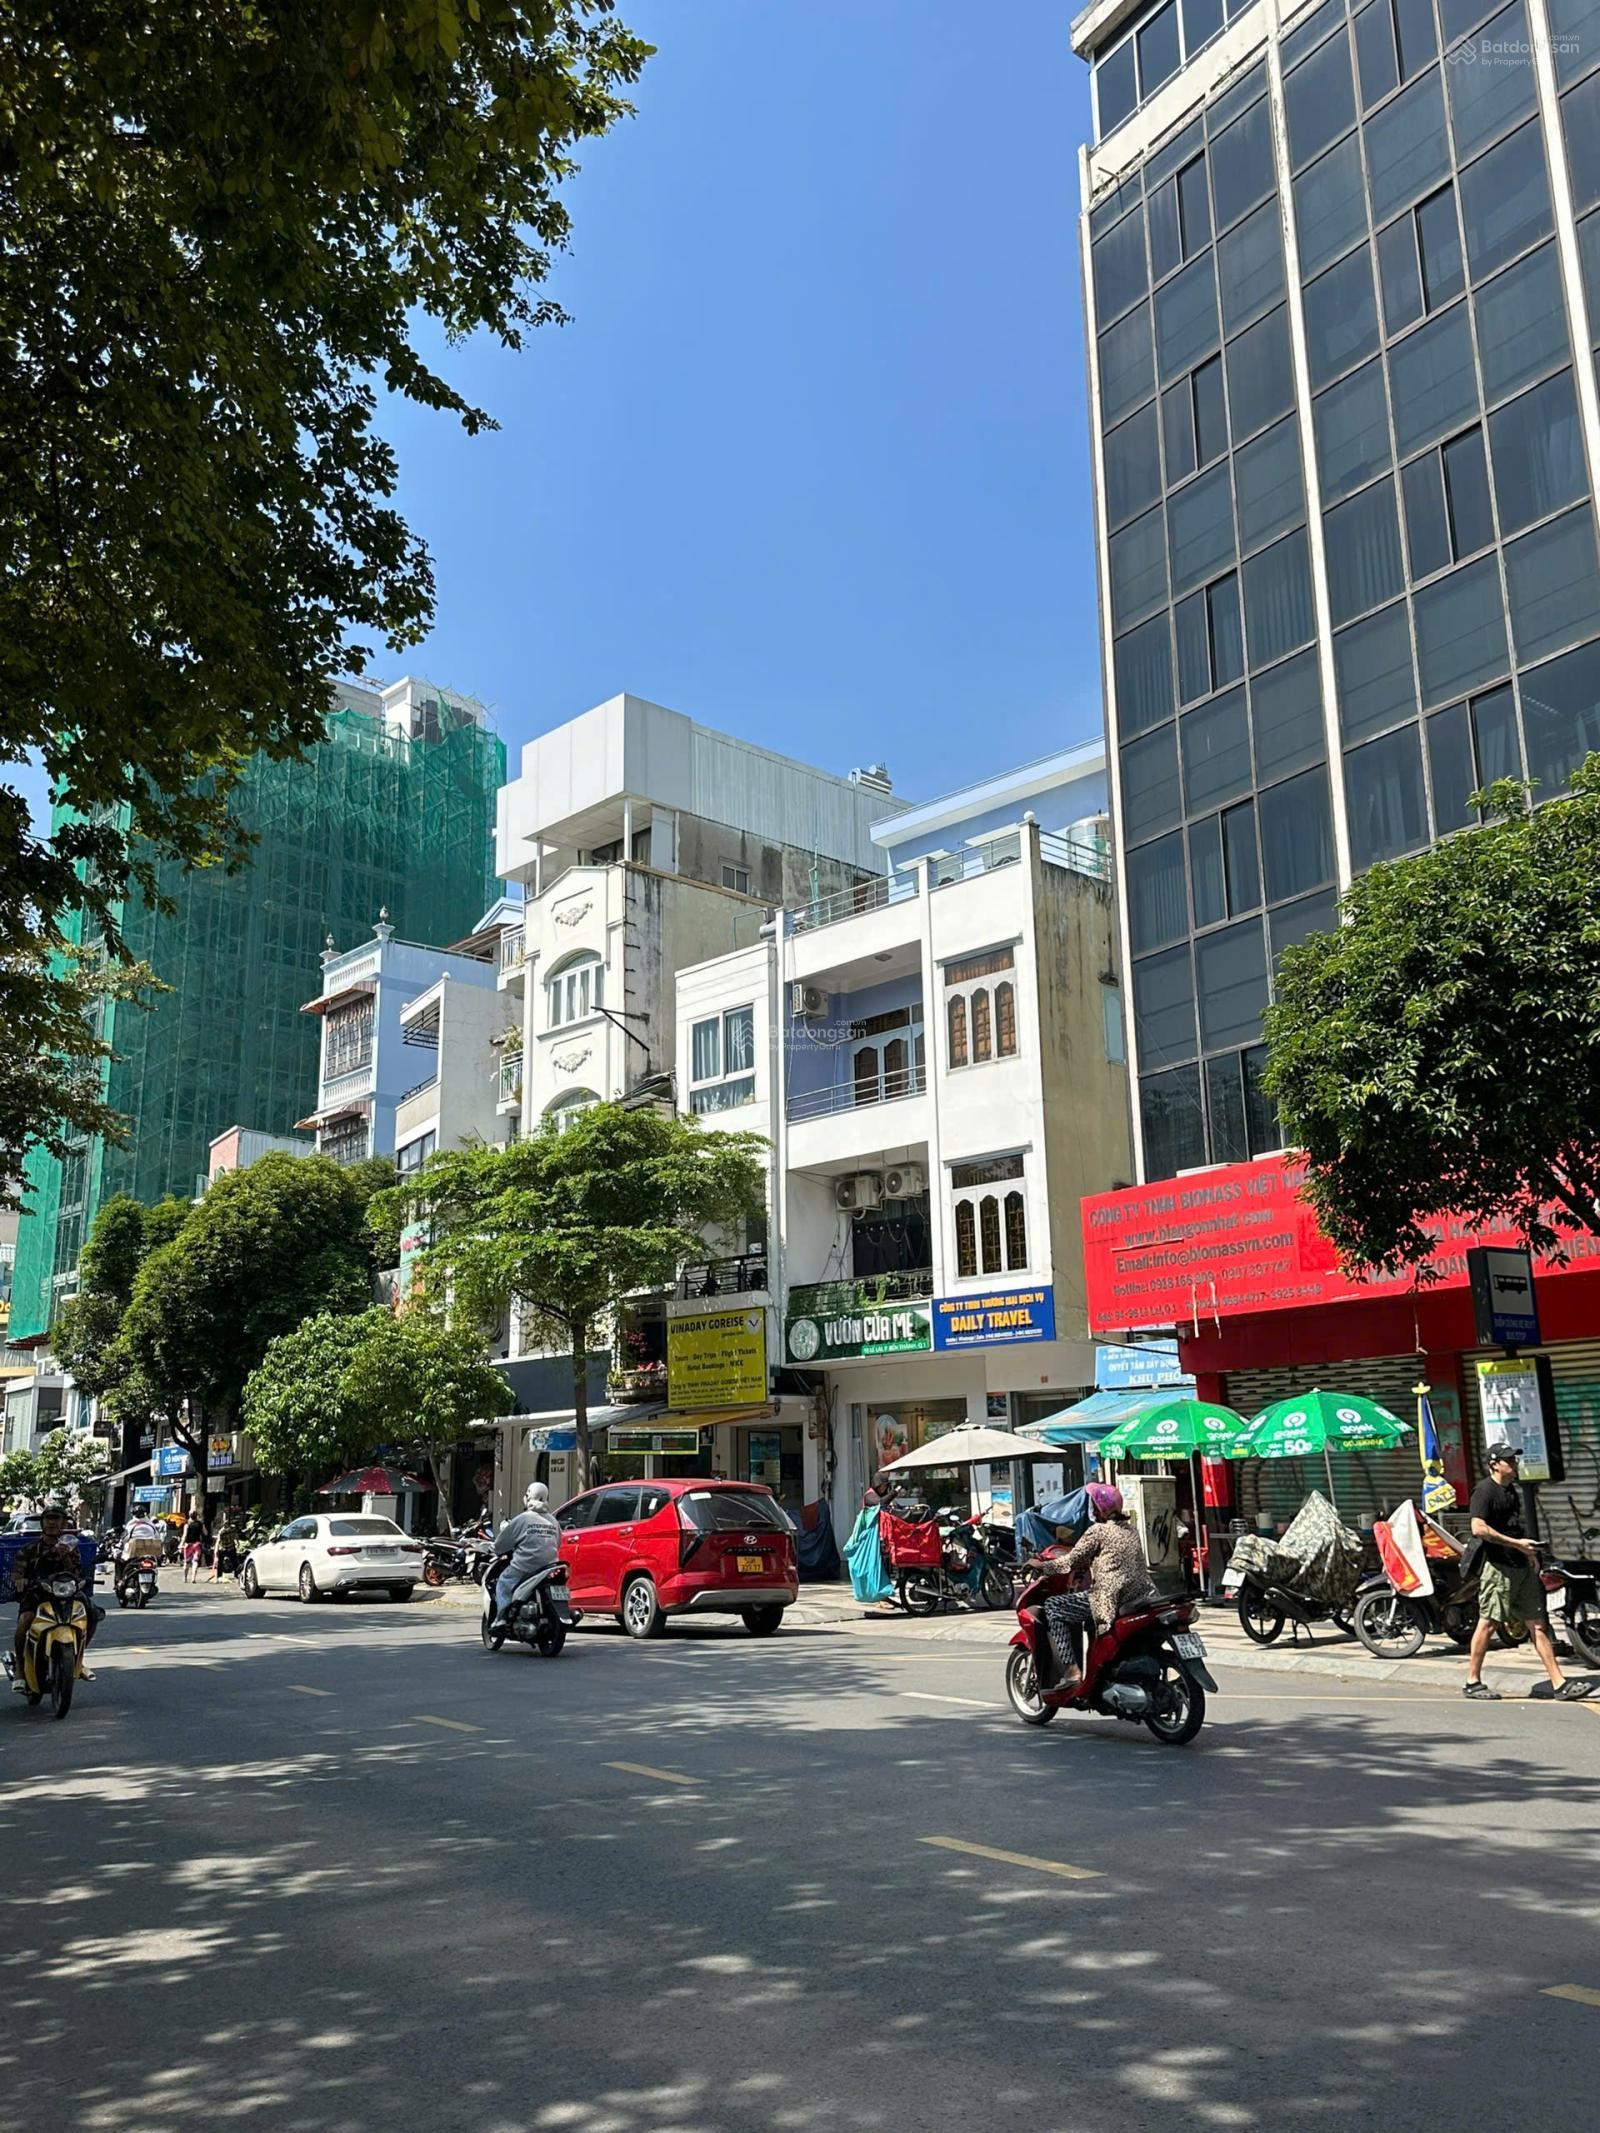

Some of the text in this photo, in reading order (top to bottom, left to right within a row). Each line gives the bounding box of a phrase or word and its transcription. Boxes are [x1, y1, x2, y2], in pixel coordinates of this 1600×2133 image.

[1125, 1203, 1140, 1223] TY
[1181, 1182, 1242, 1210] BIOMASS
[670, 1315, 744, 1334] VINADAY GOREISE
[824, 1310, 916, 1346] VƯỜN CỦA MẸ
[950, 1313, 984, 1333] DAILY
[986, 1308, 1033, 1328] TRAVEL
